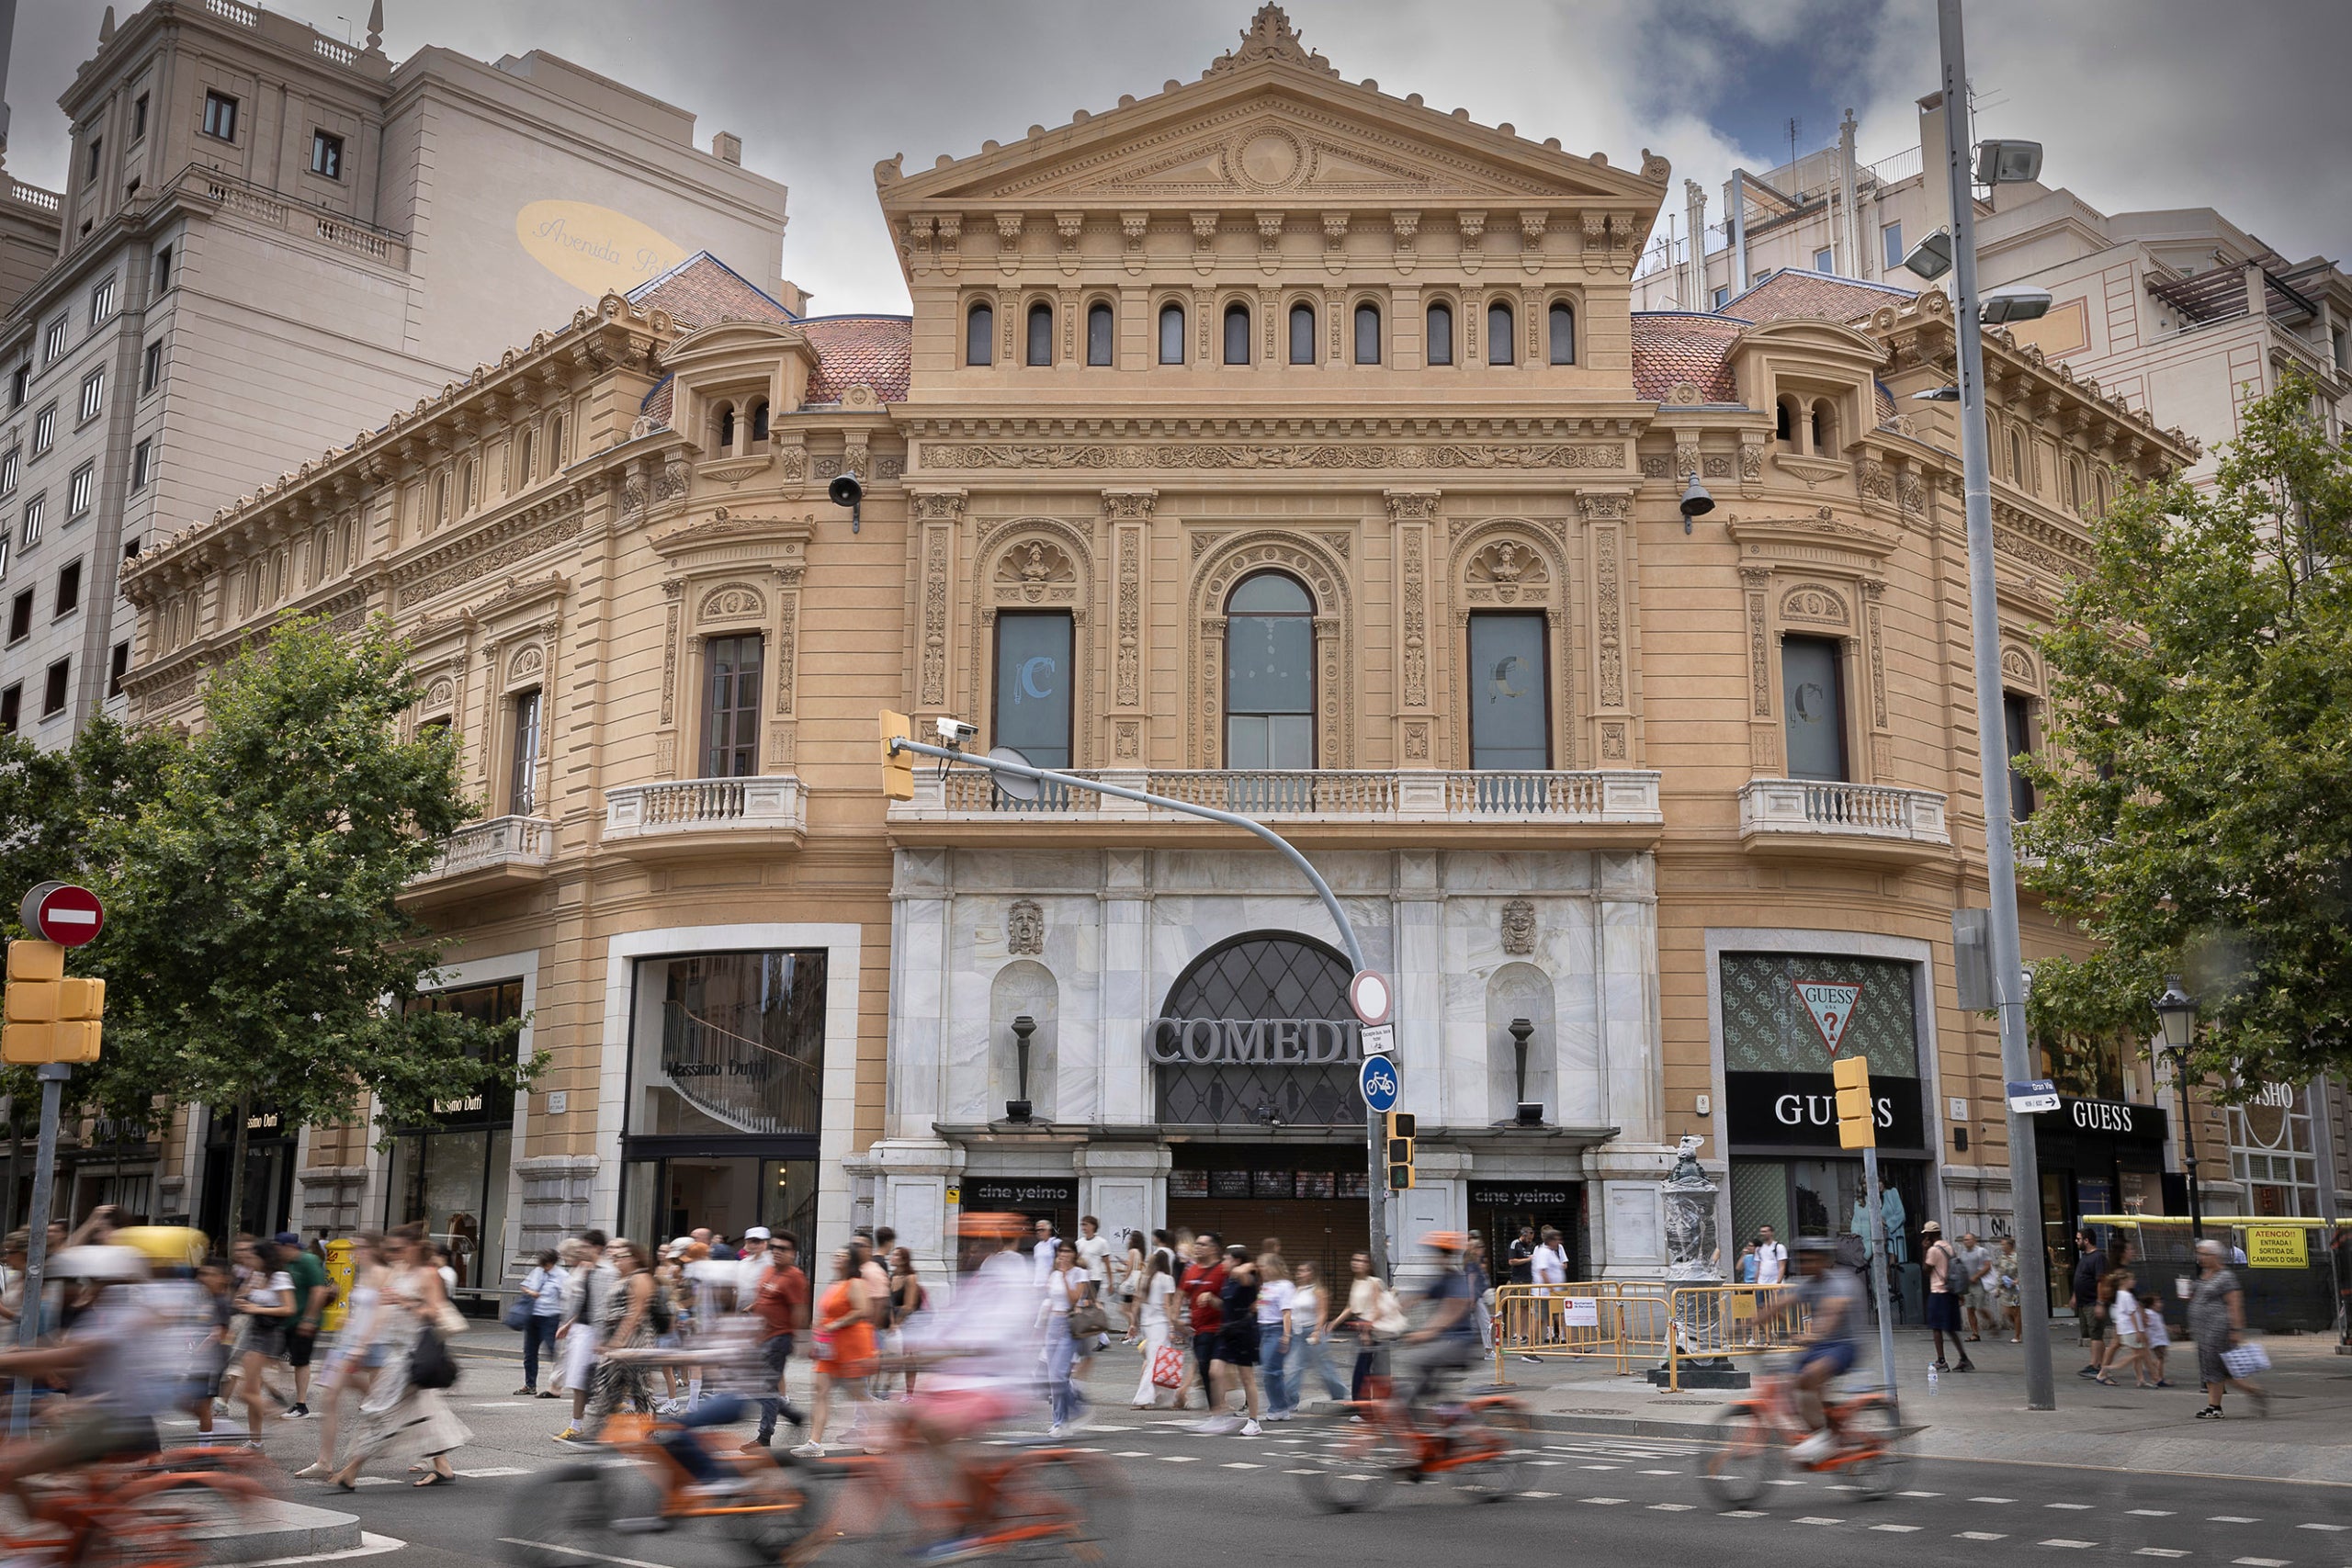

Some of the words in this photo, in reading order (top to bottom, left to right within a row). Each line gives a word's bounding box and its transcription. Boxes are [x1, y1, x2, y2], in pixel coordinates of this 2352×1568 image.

[532, 218, 620, 265] Avenida
[632, 246, 671, 276] Pal
[1805, 987, 1853, 1005] GUESS
[1146, 1017, 1400, 1066] COMEDI
[666, 1059, 722, 1077] Massimo
[464, 1094, 482, 1111] Dutti
[2245, 1080, 2293, 1109] SHO
[1775, 1094, 1893, 1128] GUS
[2073, 1100, 2132, 1132] GUESS
[978, 1184, 1012, 1198] cine
[1475, 1188, 1509, 1202] cine
[2256, 1230, 2296, 1238] ATENCIÓ!!
